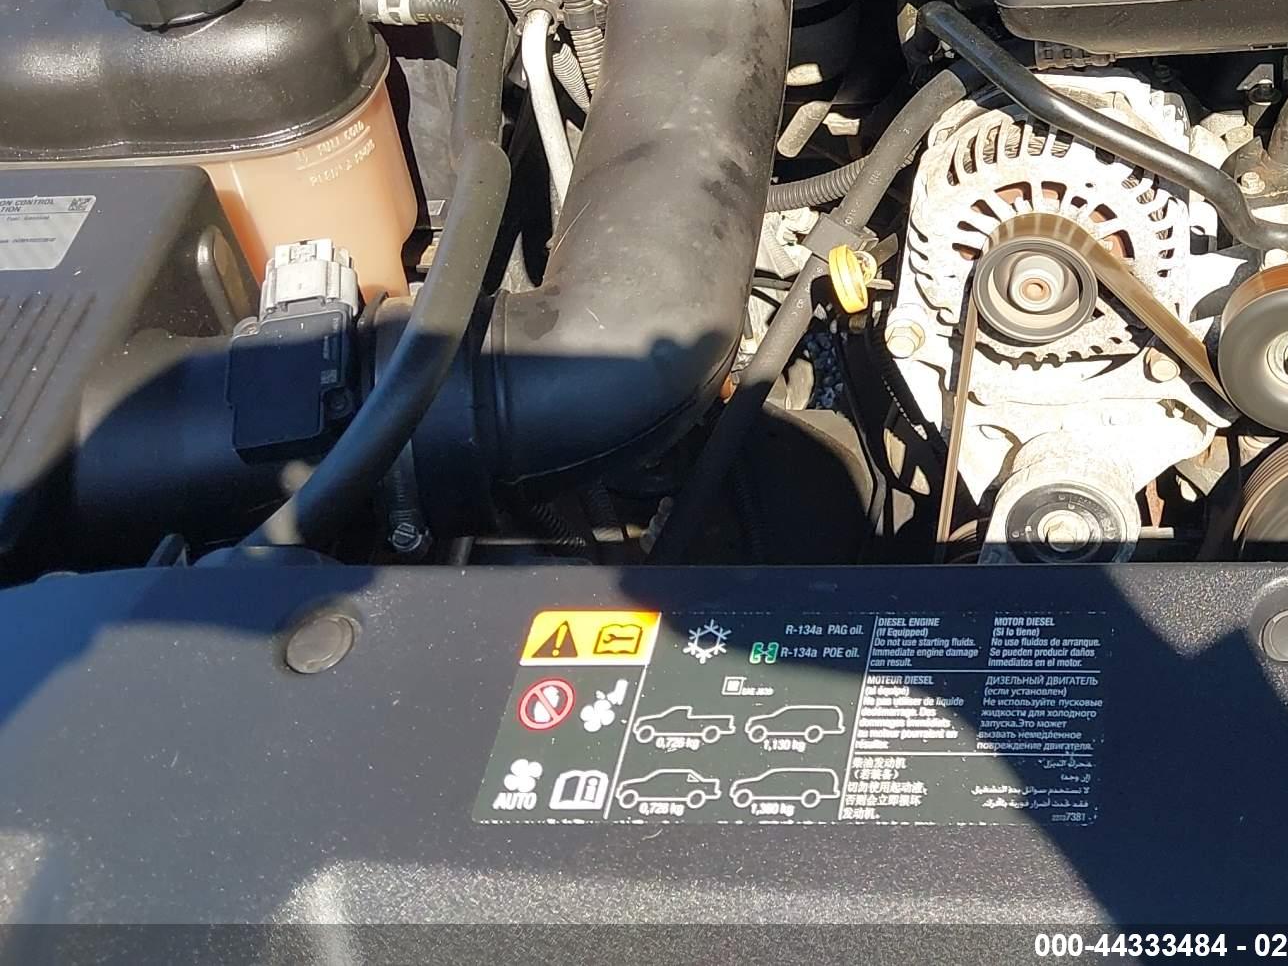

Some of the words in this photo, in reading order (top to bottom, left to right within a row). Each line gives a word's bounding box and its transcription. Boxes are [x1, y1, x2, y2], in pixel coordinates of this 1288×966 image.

[14, 198, 54, 206] CONTROL
[878, 617, 907, 627] DIESEL
[908, 617, 940, 627] ENGINE
[994, 617, 1024, 626] MOTOR
[1025, 617, 1056, 626] DIESEL
[785, 625, 823, 635] R-134a
[827, 625, 848, 635] PAG
[849, 625, 864, 635] oil.
[887, 627, 929, 638] Equipped)
[1016, 627, 1040, 637] tiene)
[874, 638, 886, 646] Do
[887, 638, 901, 646] not
[918, 638, 949, 648] starting
[951, 638, 976, 646] fluids.
[991, 637, 1003, 646] No
[1021, 637, 1048, 646] fluidos
[1050, 637, 1060, 646] de
[1062, 638, 1101, 648] arranque.
[780, 647, 818, 658] R-134a
[822, 647, 844, 658] POE
[845, 647, 861, 658] oil.
[872, 647, 915, 656] Immediate
[916, 648, 944, 658] engine
[945, 648, 979, 658] damage
[989, 647, 1000, 656] Se
[1001, 647, 1032, 658] pueden
[1034, 647, 1069, 658] producir
[1070, 647, 1095, 657] daños
[886, 657, 912, 666] result.
[1047, 657, 1055, 666] el
[1056, 658, 1082, 667] motor.
[866, 675, 902, 685] MOTEUR
[904, 675, 934, 685] DIESEL
[985, 675, 1044, 685] ДИЗЕЛЬНЫЙ
[1045, 676, 1099, 686] ДВИГАТЕЛЬ
[984, 686, 1009, 696] (если
[1010, 686, 1067, 697] установлен)
[923, 696, 934, 706] de
[936, 696, 964, 708] liquide
[982, 697, 996, 706] Не
[997, 697, 1056, 708] используйте
[1058, 699, 1103, 708] пусковые
[981, 709, 1026, 718] жидкости
[1028, 709, 1046, 718] для
[1046, 709, 1097, 719] холодного
[1036, 720, 1067, 728] может
[976, 741, 1042, 751] повреждение
[1043, 742, 1094, 751] двигателя.
[492, 792, 537, 810] AUTO
